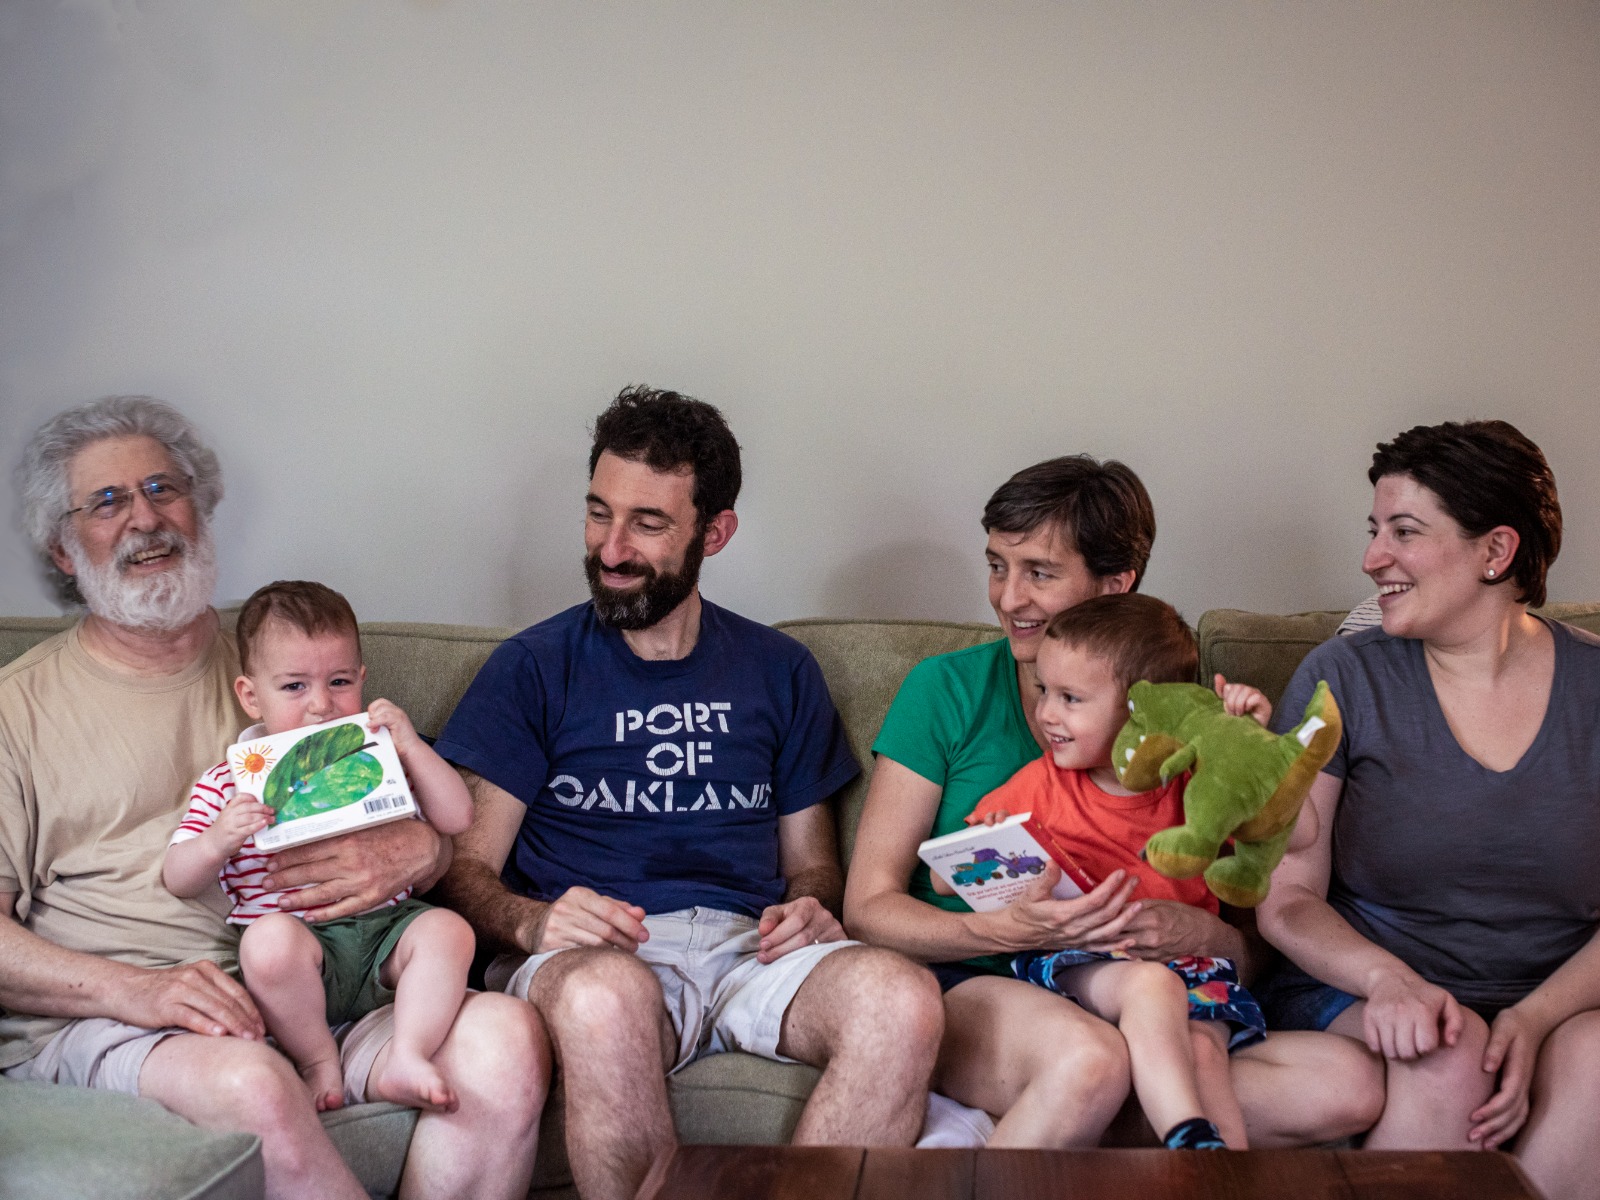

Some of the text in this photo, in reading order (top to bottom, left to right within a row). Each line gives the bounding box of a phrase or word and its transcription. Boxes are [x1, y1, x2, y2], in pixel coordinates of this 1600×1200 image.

[615, 702, 732, 742] PORT
[645, 741, 713, 776] OF
[547, 774, 773, 813] OAKLAND
